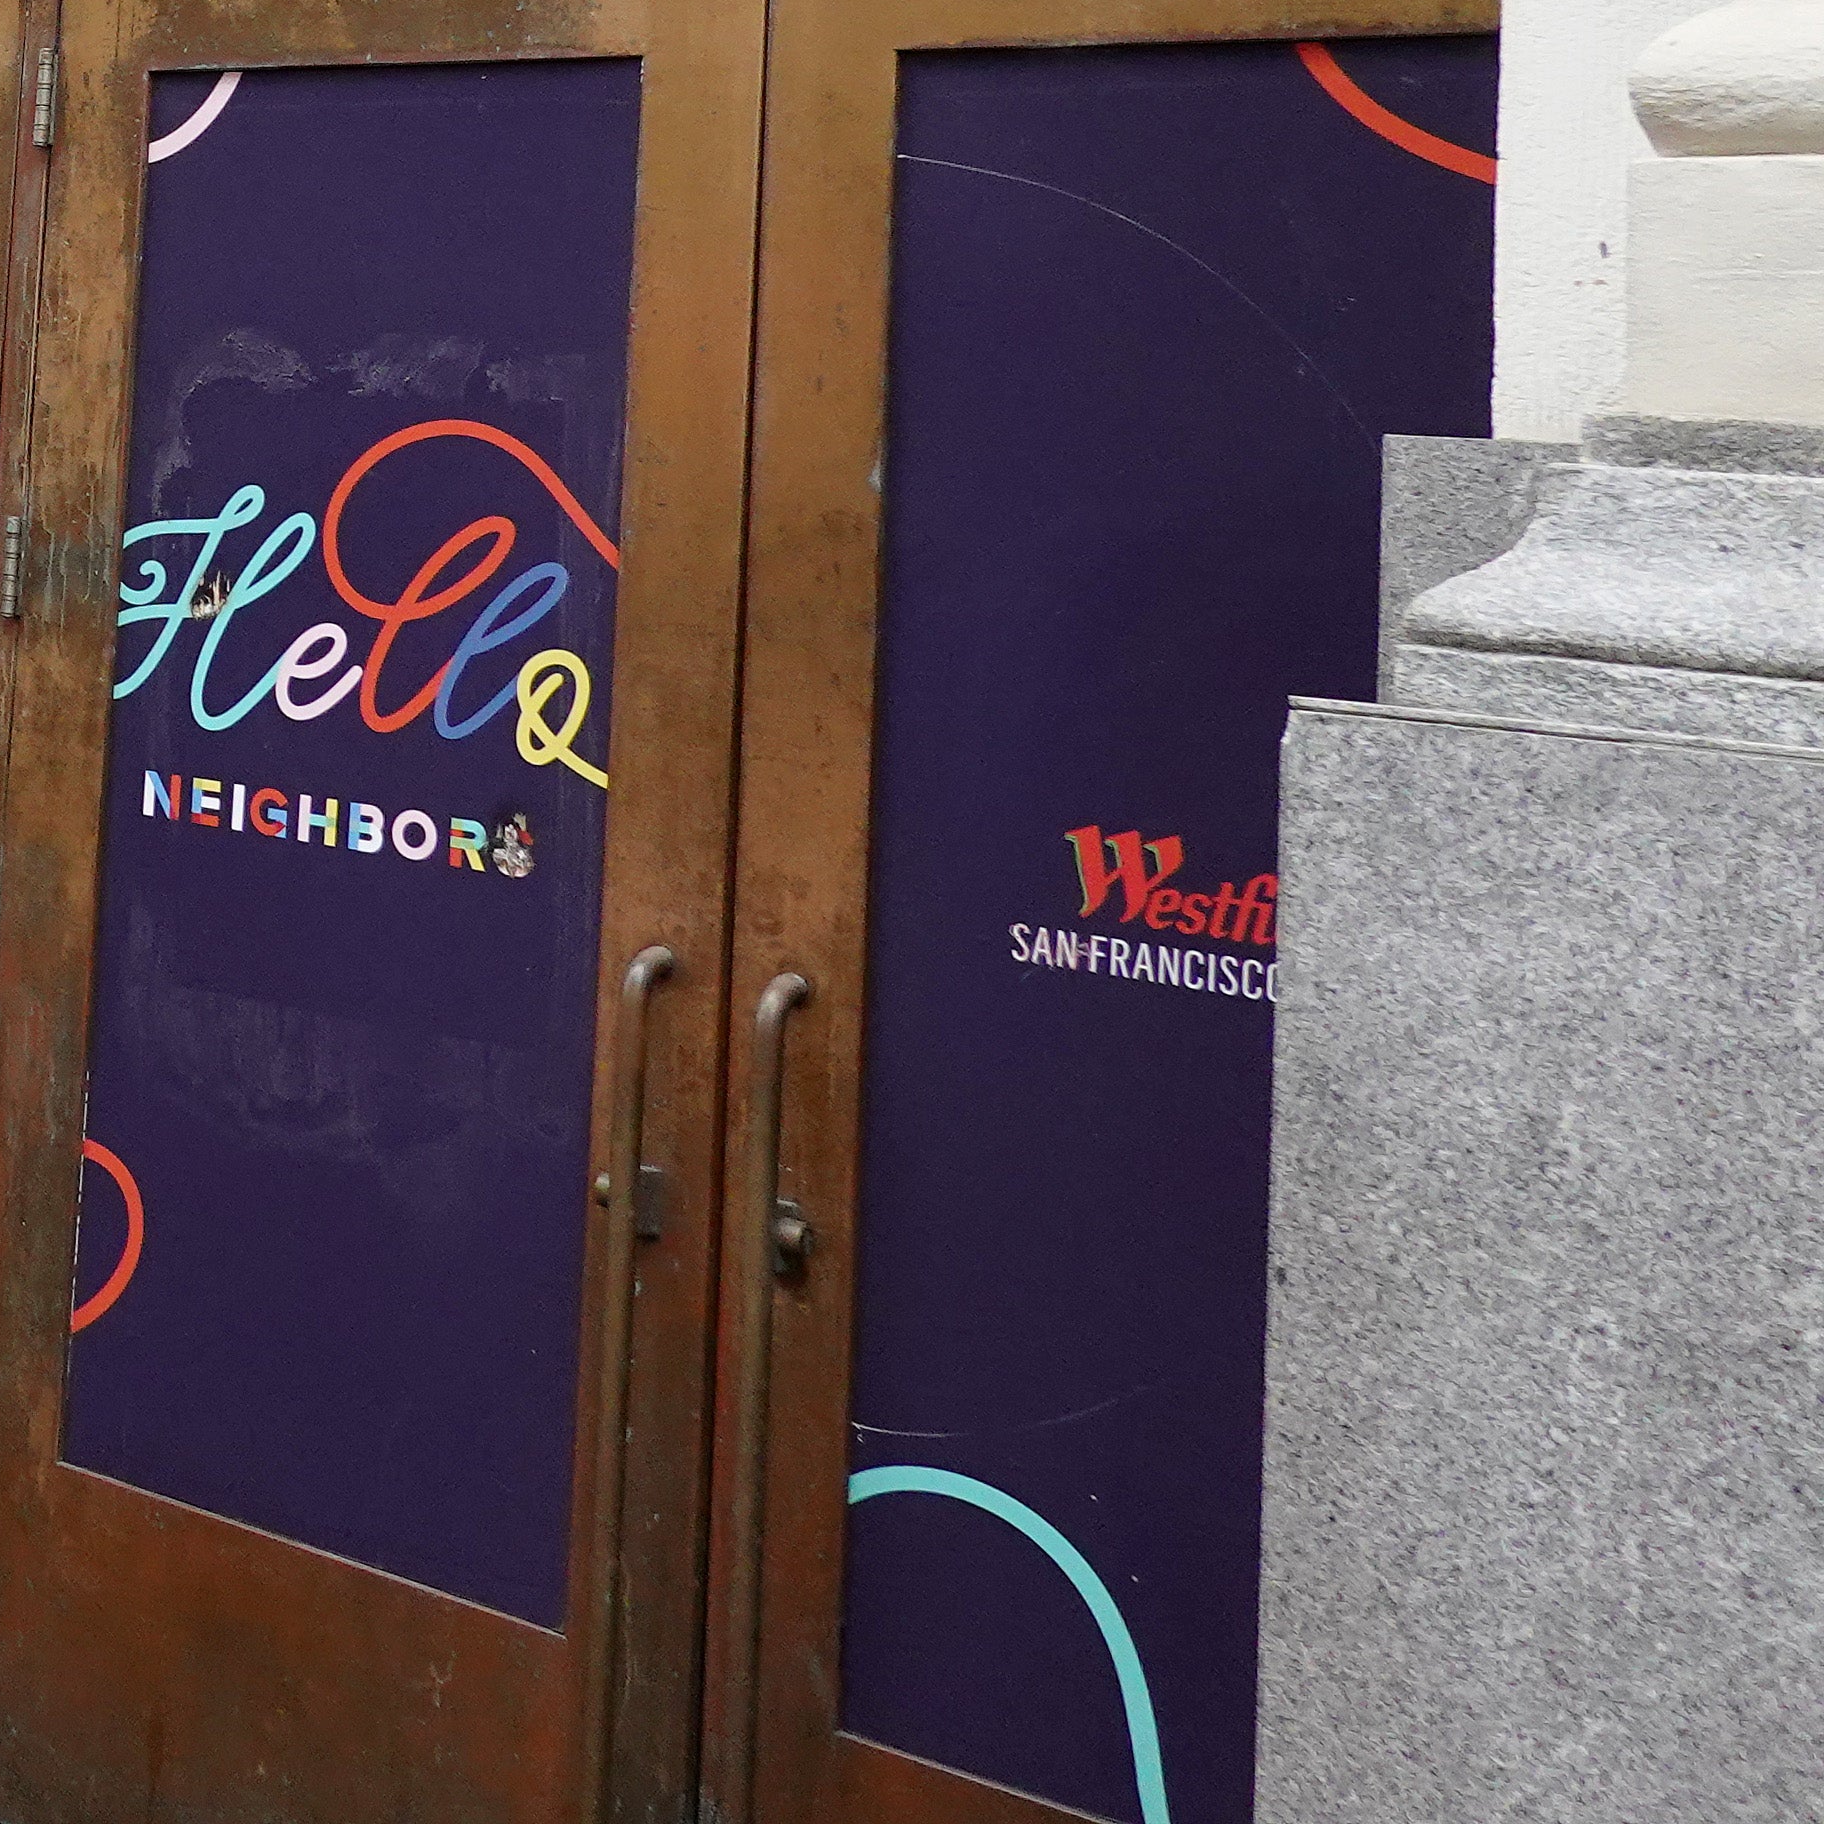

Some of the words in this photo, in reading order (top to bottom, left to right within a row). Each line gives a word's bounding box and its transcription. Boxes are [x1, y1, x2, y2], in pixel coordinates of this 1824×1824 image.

[113, 419, 619, 789] Hello
[142, 770, 535, 878] NEIGHBOR
[1009, 922, 1078, 971] SAN
